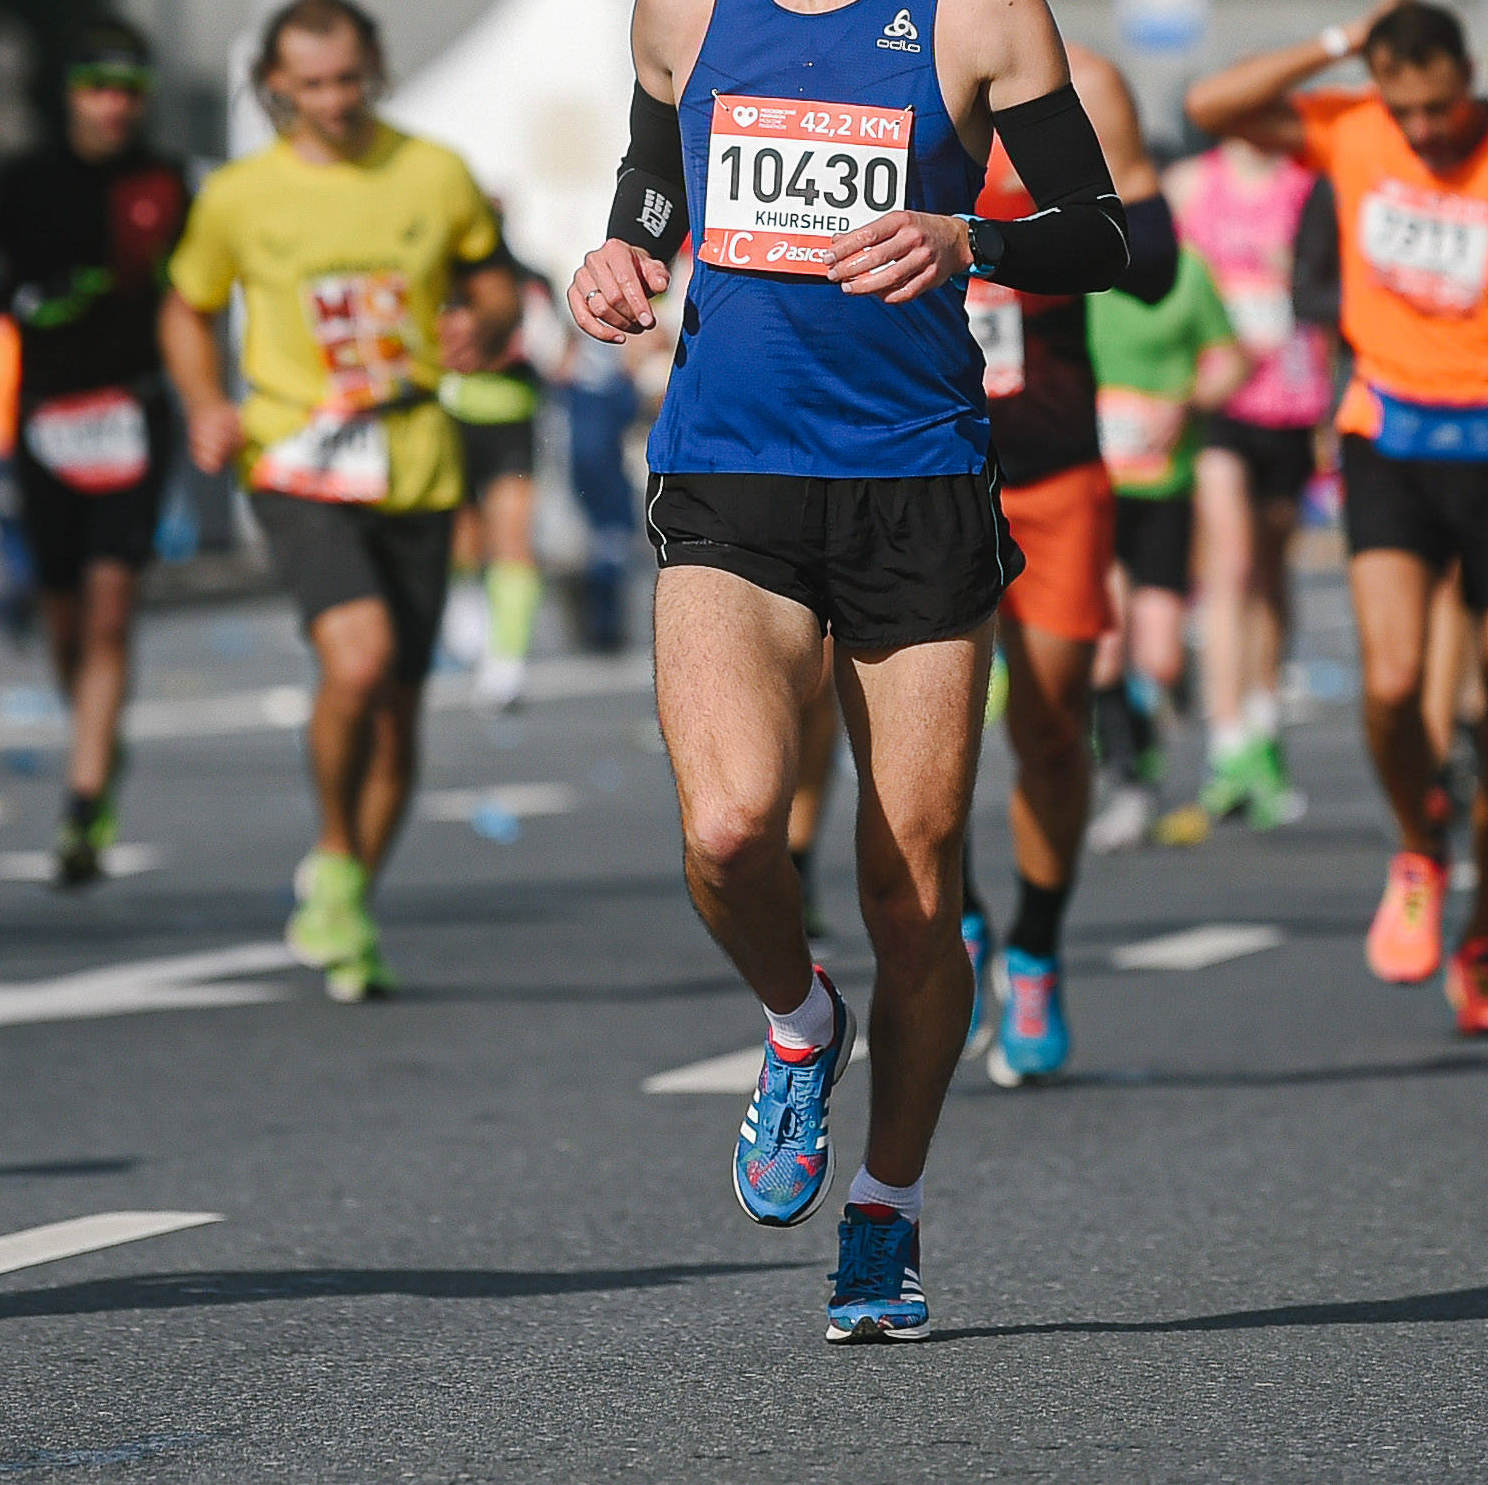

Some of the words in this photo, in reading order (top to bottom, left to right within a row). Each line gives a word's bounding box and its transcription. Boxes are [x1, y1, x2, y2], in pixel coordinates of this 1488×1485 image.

[876, 39, 921, 53] odlo
[799, 111, 853, 138] 42,2
[859, 116, 901, 141] KM
[721, 145, 899, 212] 10430
[754, 211, 851, 232] KHURSHED
[727, 231, 754, 265] C
